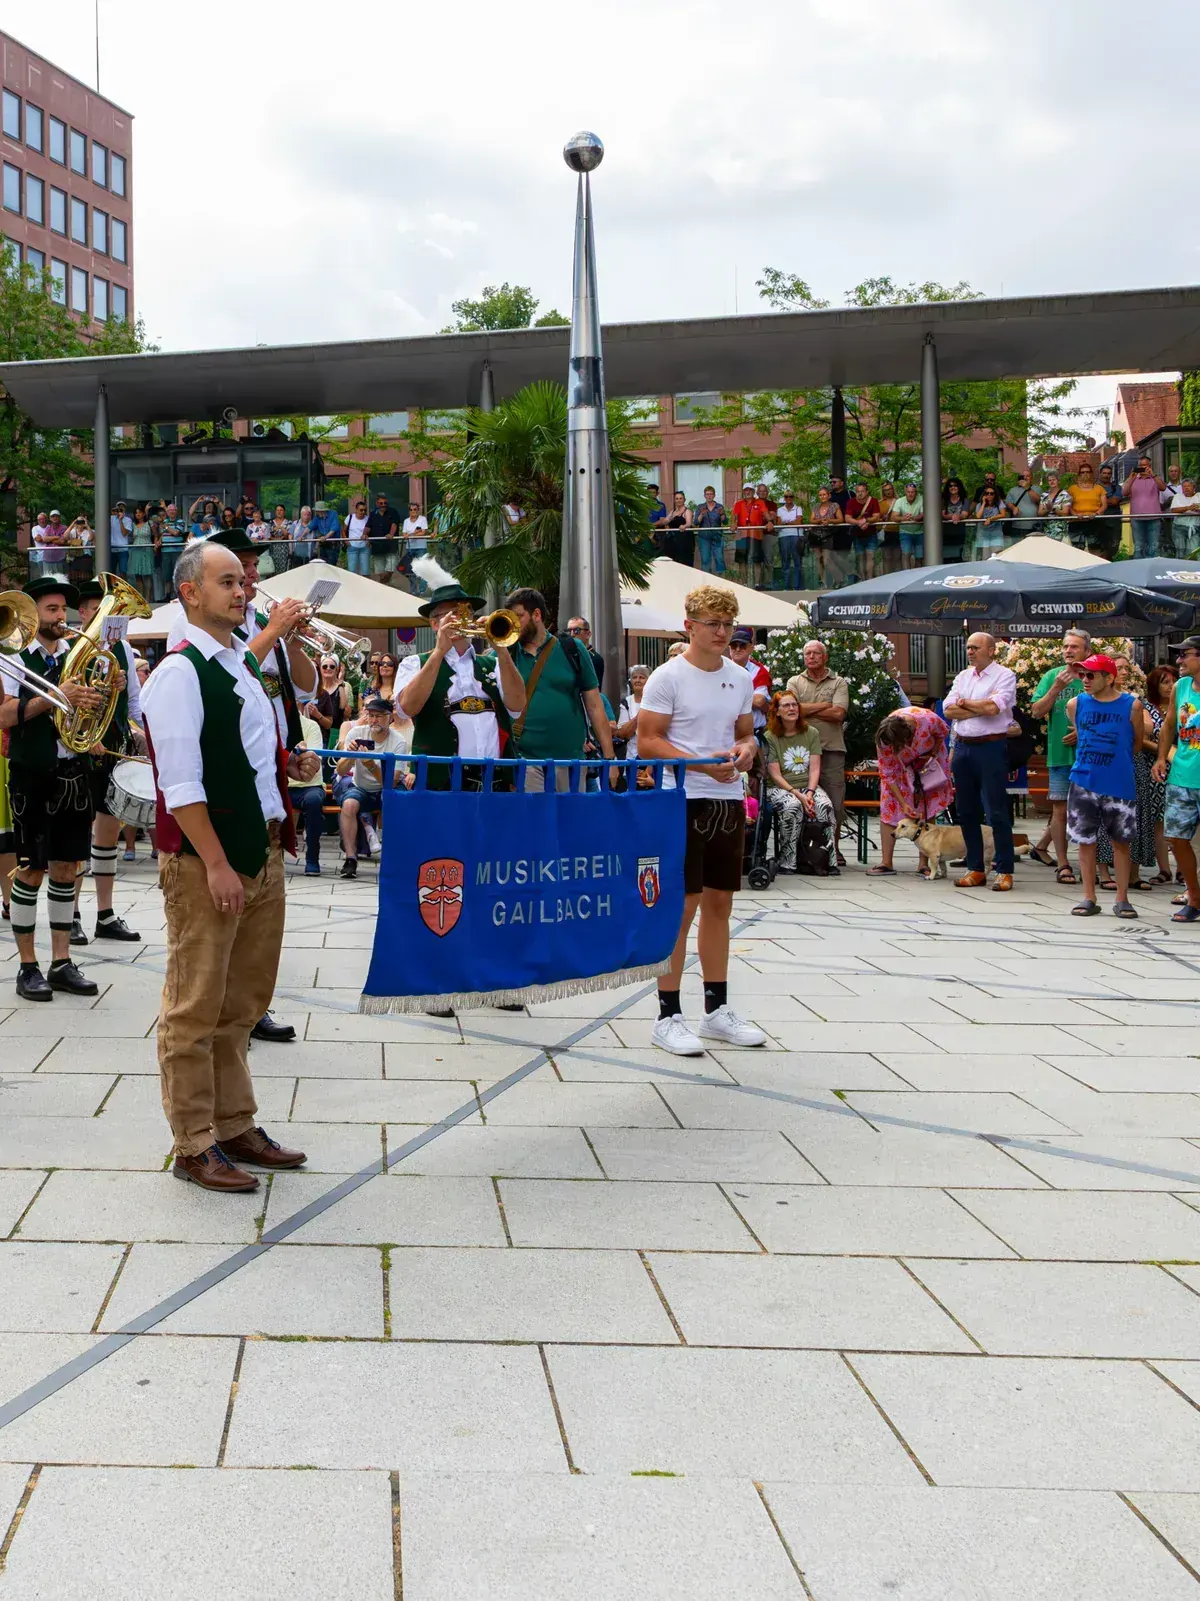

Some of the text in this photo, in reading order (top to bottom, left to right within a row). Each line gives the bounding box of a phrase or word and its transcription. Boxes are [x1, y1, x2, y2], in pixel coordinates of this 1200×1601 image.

[828, 605, 871, 616] SCHWIND
[1031, 602, 1116, 614] SCHWIND BRÄU
[492, 894, 611, 926] GAILBACH
